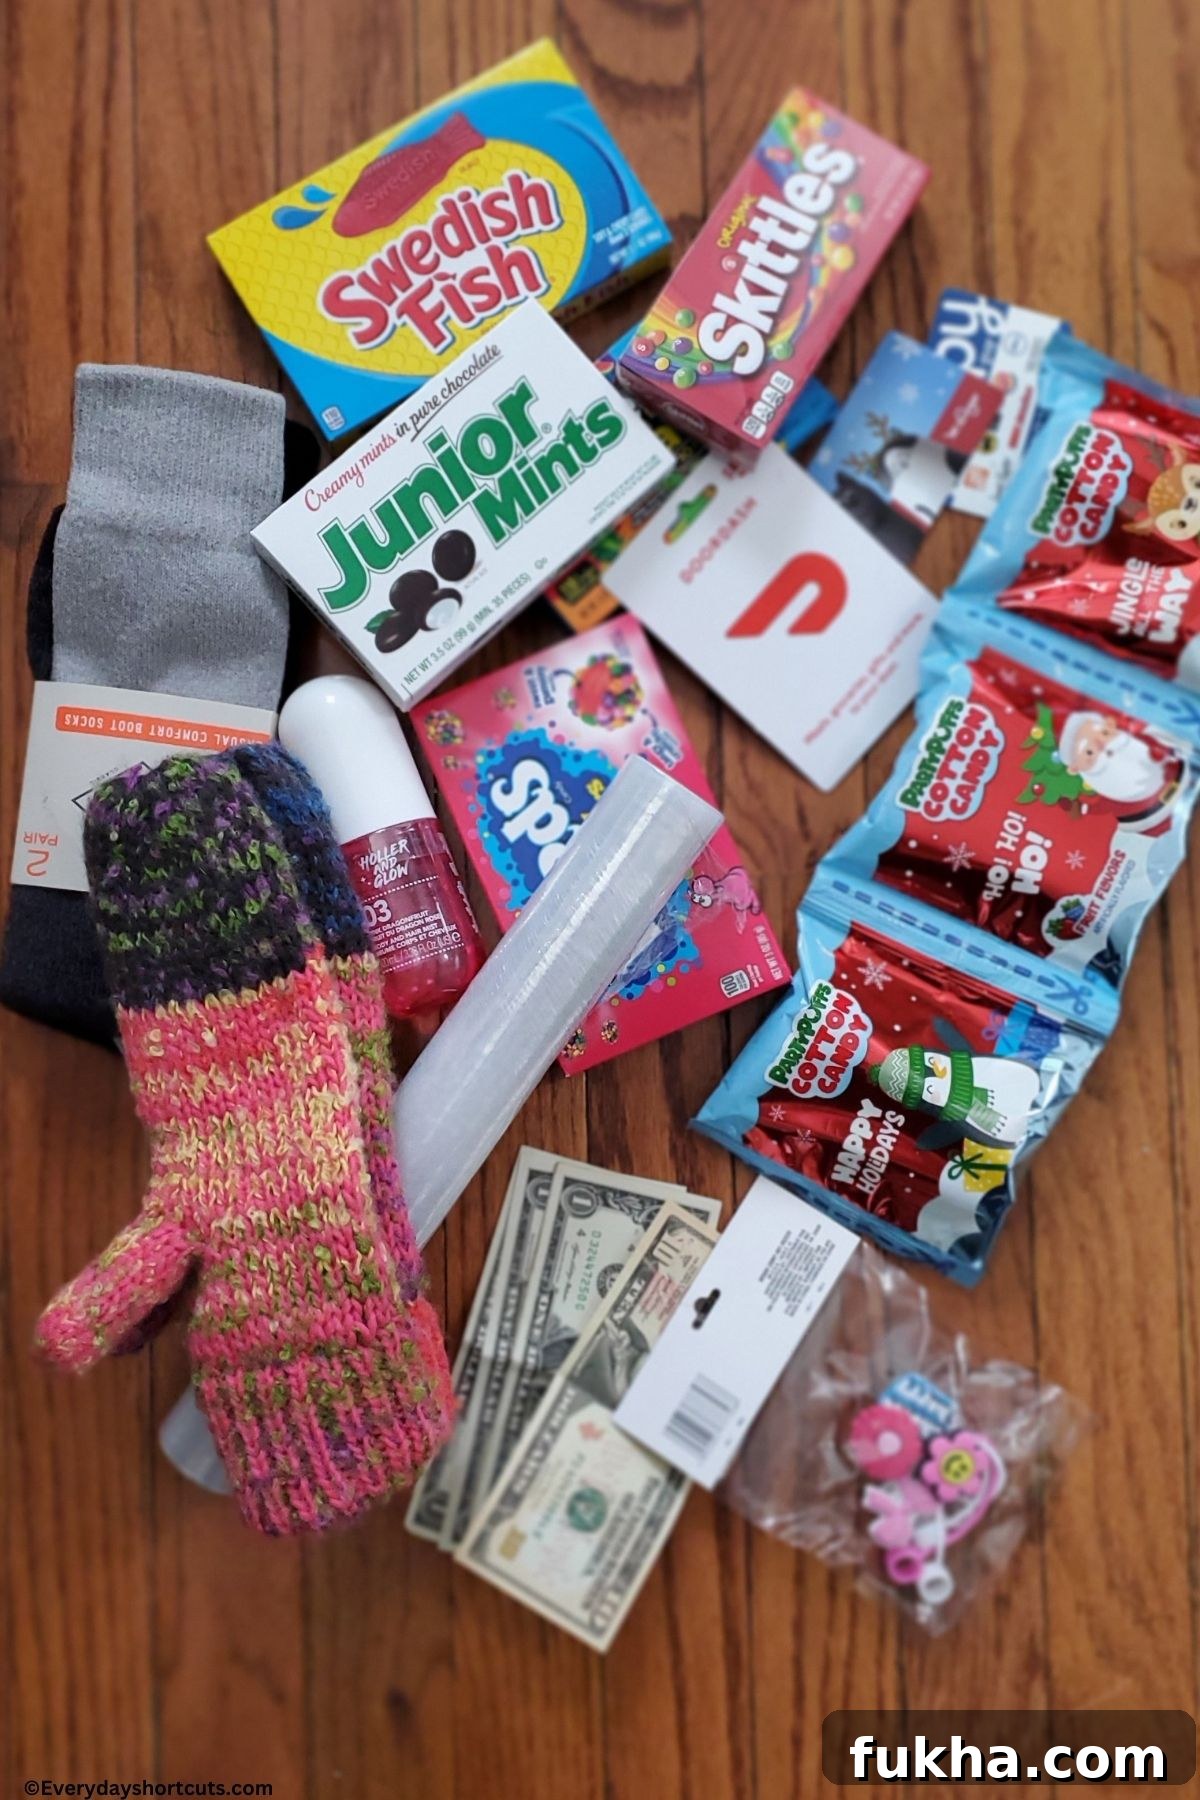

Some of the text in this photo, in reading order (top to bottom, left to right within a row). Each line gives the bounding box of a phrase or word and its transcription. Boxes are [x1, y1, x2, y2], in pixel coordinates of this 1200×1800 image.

[319, 169, 558, 349] Swedish
[698, 142, 857, 376] Skittles
[395, 240, 548, 353] Fish
[304, 342, 502, 512] Creamy mints in pure chocolate
[317, 376, 538, 613] Junior
[469, 397, 626, 549] Mints
[1054, 432, 1115, 542] COTTON
[1079, 456, 1127, 540] CANDY
[1149, 568, 1193, 643] WAY
[403, 667, 421, 685] NET
[416, 657, 433, 673] WT
[428, 646, 445, 662] 3.5
[441, 636, 456, 651] OZ
[64, 713, 263, 748] SUAL COMFORT BOOT SOCKS
[923, 707, 988, 817] COTTON
[949, 729, 999, 815] CANDY
[23, 831, 58, 847] PAIR
[26, 849, 50, 877] 2
[359, 839, 411, 871] HOLLER
[373, 856, 398, 876] AND
[982, 810, 1027, 902] HO! HO!
[1011, 832, 1053, 895] HO!
[373, 862, 409, 889] GLOW
[363, 899, 392, 928] 03
[381, 909, 429, 930] DRAGONFRUIT
[385, 928, 395, 937] DU
[395, 918, 424, 933] DRAGON
[424, 912, 441, 923] ROSE
[389, 934, 405, 944] AND
[404, 928, 422, 938] HAIR
[422, 922, 438, 932] MIST
[1075, 902, 1101, 934] FRUIT
[395, 936, 418, 948] CORPS
[760, 941, 771, 953] OZ
[765, 955, 778, 968] WT
[721, 975, 739, 996] 100
[770, 966, 783, 980] NET
[791, 992, 854, 1094] COTTON
[818, 1011, 869, 1094] CANDY
[831, 1098, 882, 1185] HAPPY
[856, 1110, 906, 1196] HOLIDAYS
